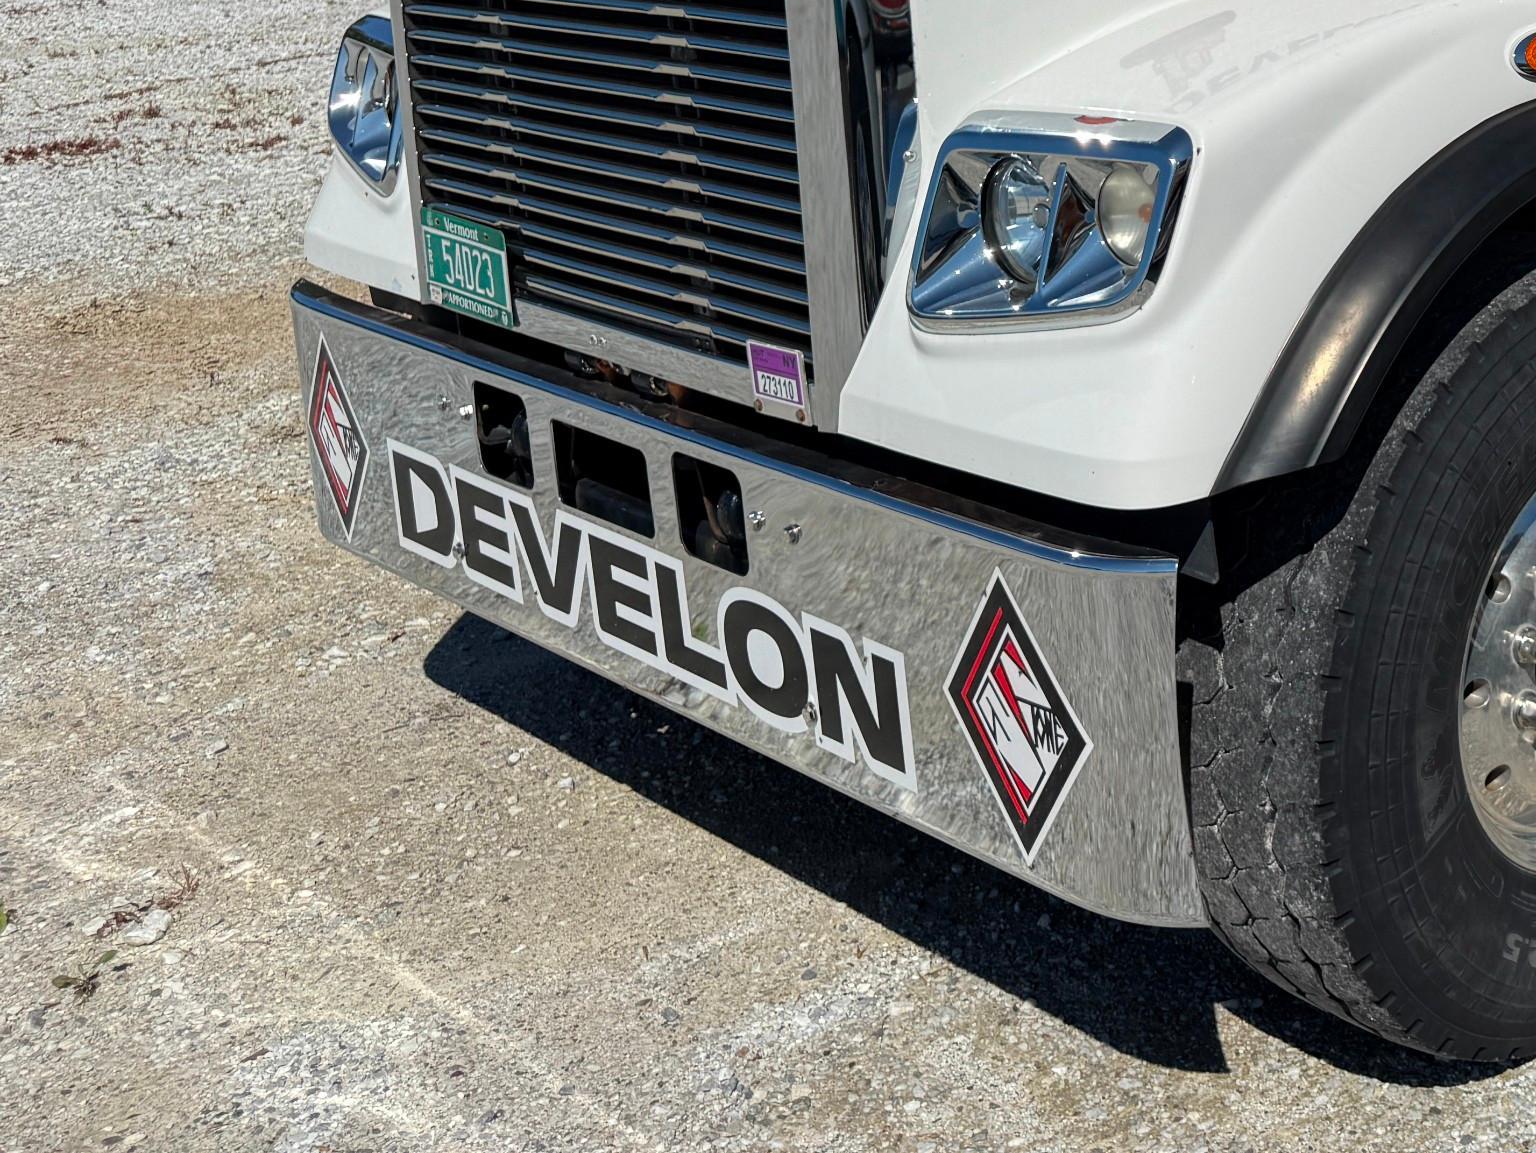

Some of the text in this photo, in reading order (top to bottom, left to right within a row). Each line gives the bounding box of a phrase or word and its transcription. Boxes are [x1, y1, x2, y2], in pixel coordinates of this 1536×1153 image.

[444, 217, 479, 241] Vermont
[448, 292, 494, 319] APPORTIONED
[761, 373, 795, 400] 273110
[390, 446, 912, 783] DEVELON
